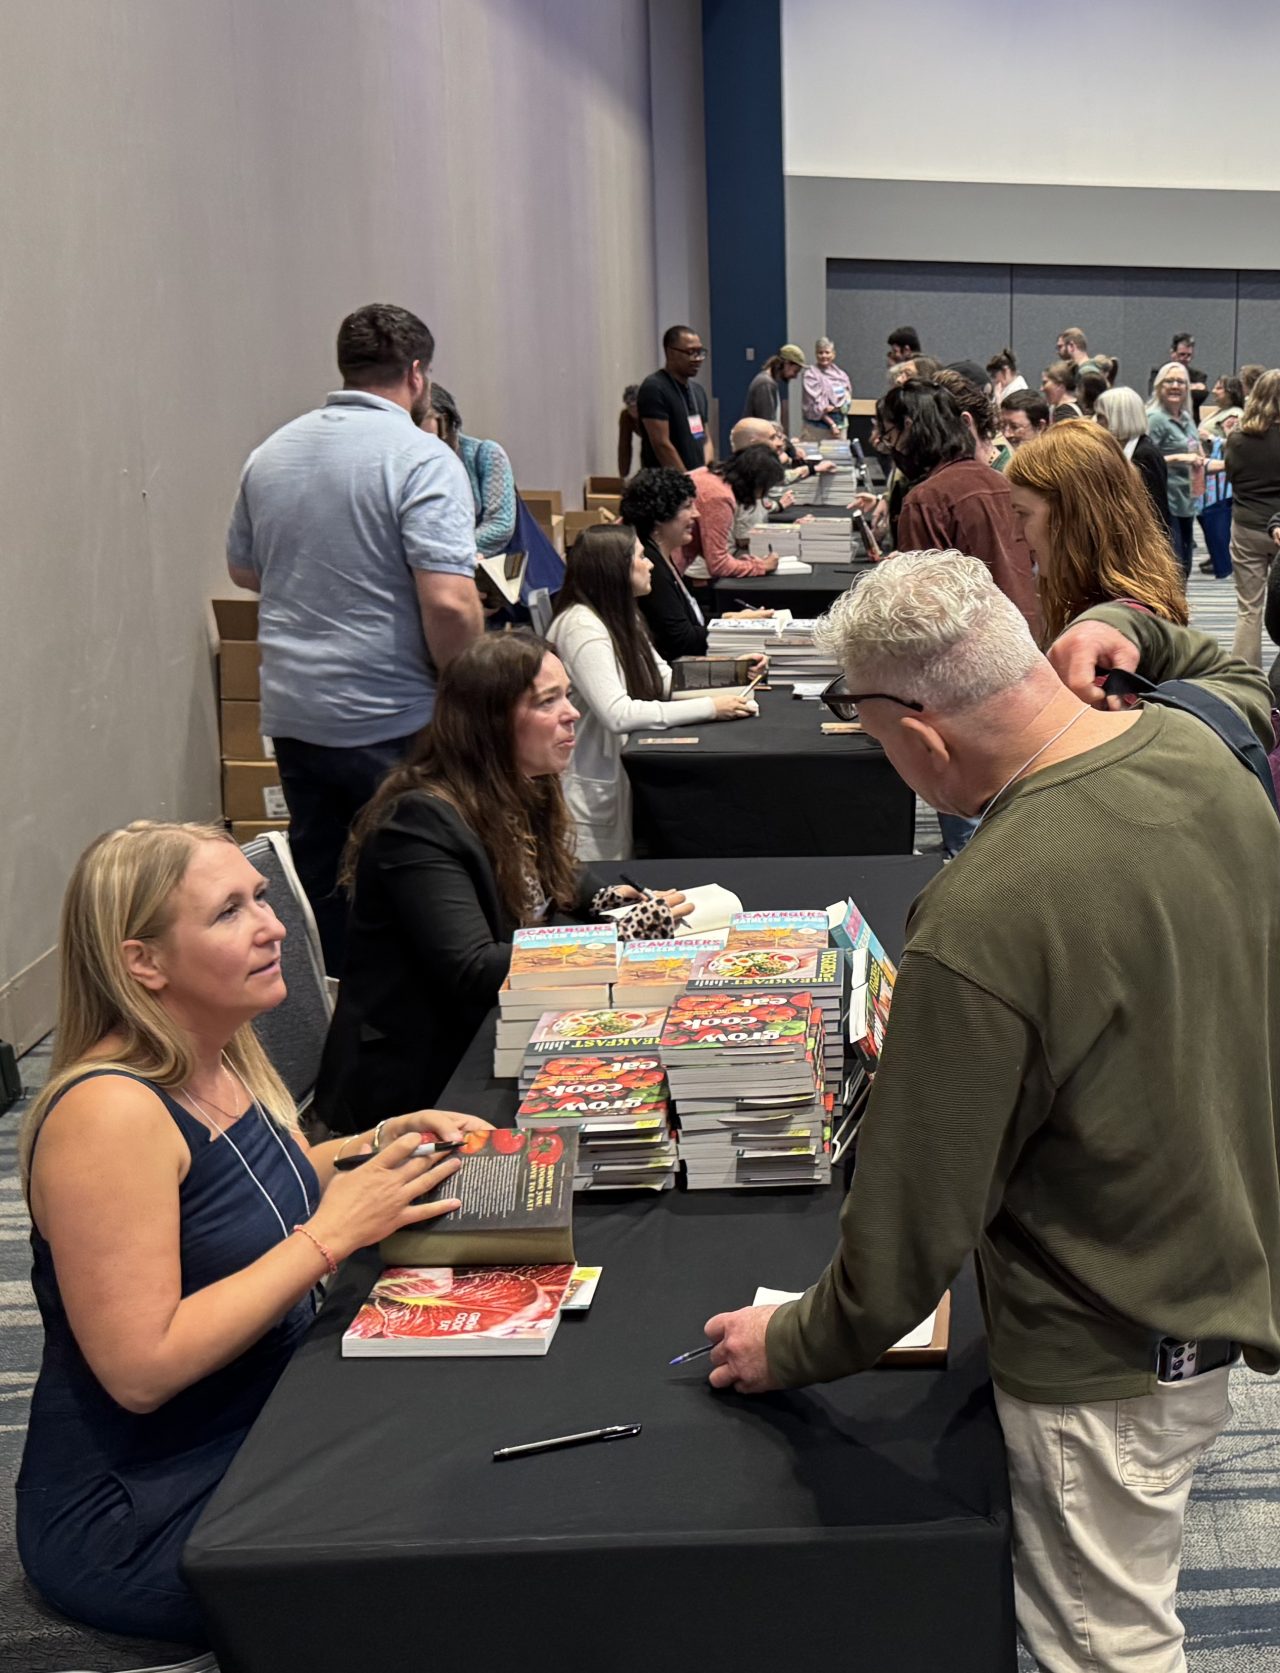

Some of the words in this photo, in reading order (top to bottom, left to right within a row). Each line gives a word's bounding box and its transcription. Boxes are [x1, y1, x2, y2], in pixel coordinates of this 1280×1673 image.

[733, 911, 825, 919] SCAVENGERS
[517, 925, 612, 937] SCAVENGERS
[628, 939, 721, 949] SCAVENGERS
[739, 997, 788, 1007] eat
[682, 1016, 758, 1030] cook
[697, 1029, 781, 1043] grow
[570, 1037, 661, 1049] REAKFAST
[610, 1060, 658, 1072] eat
[546, 1083, 624, 1096] cook
[557, 1096, 644, 1111] grow
